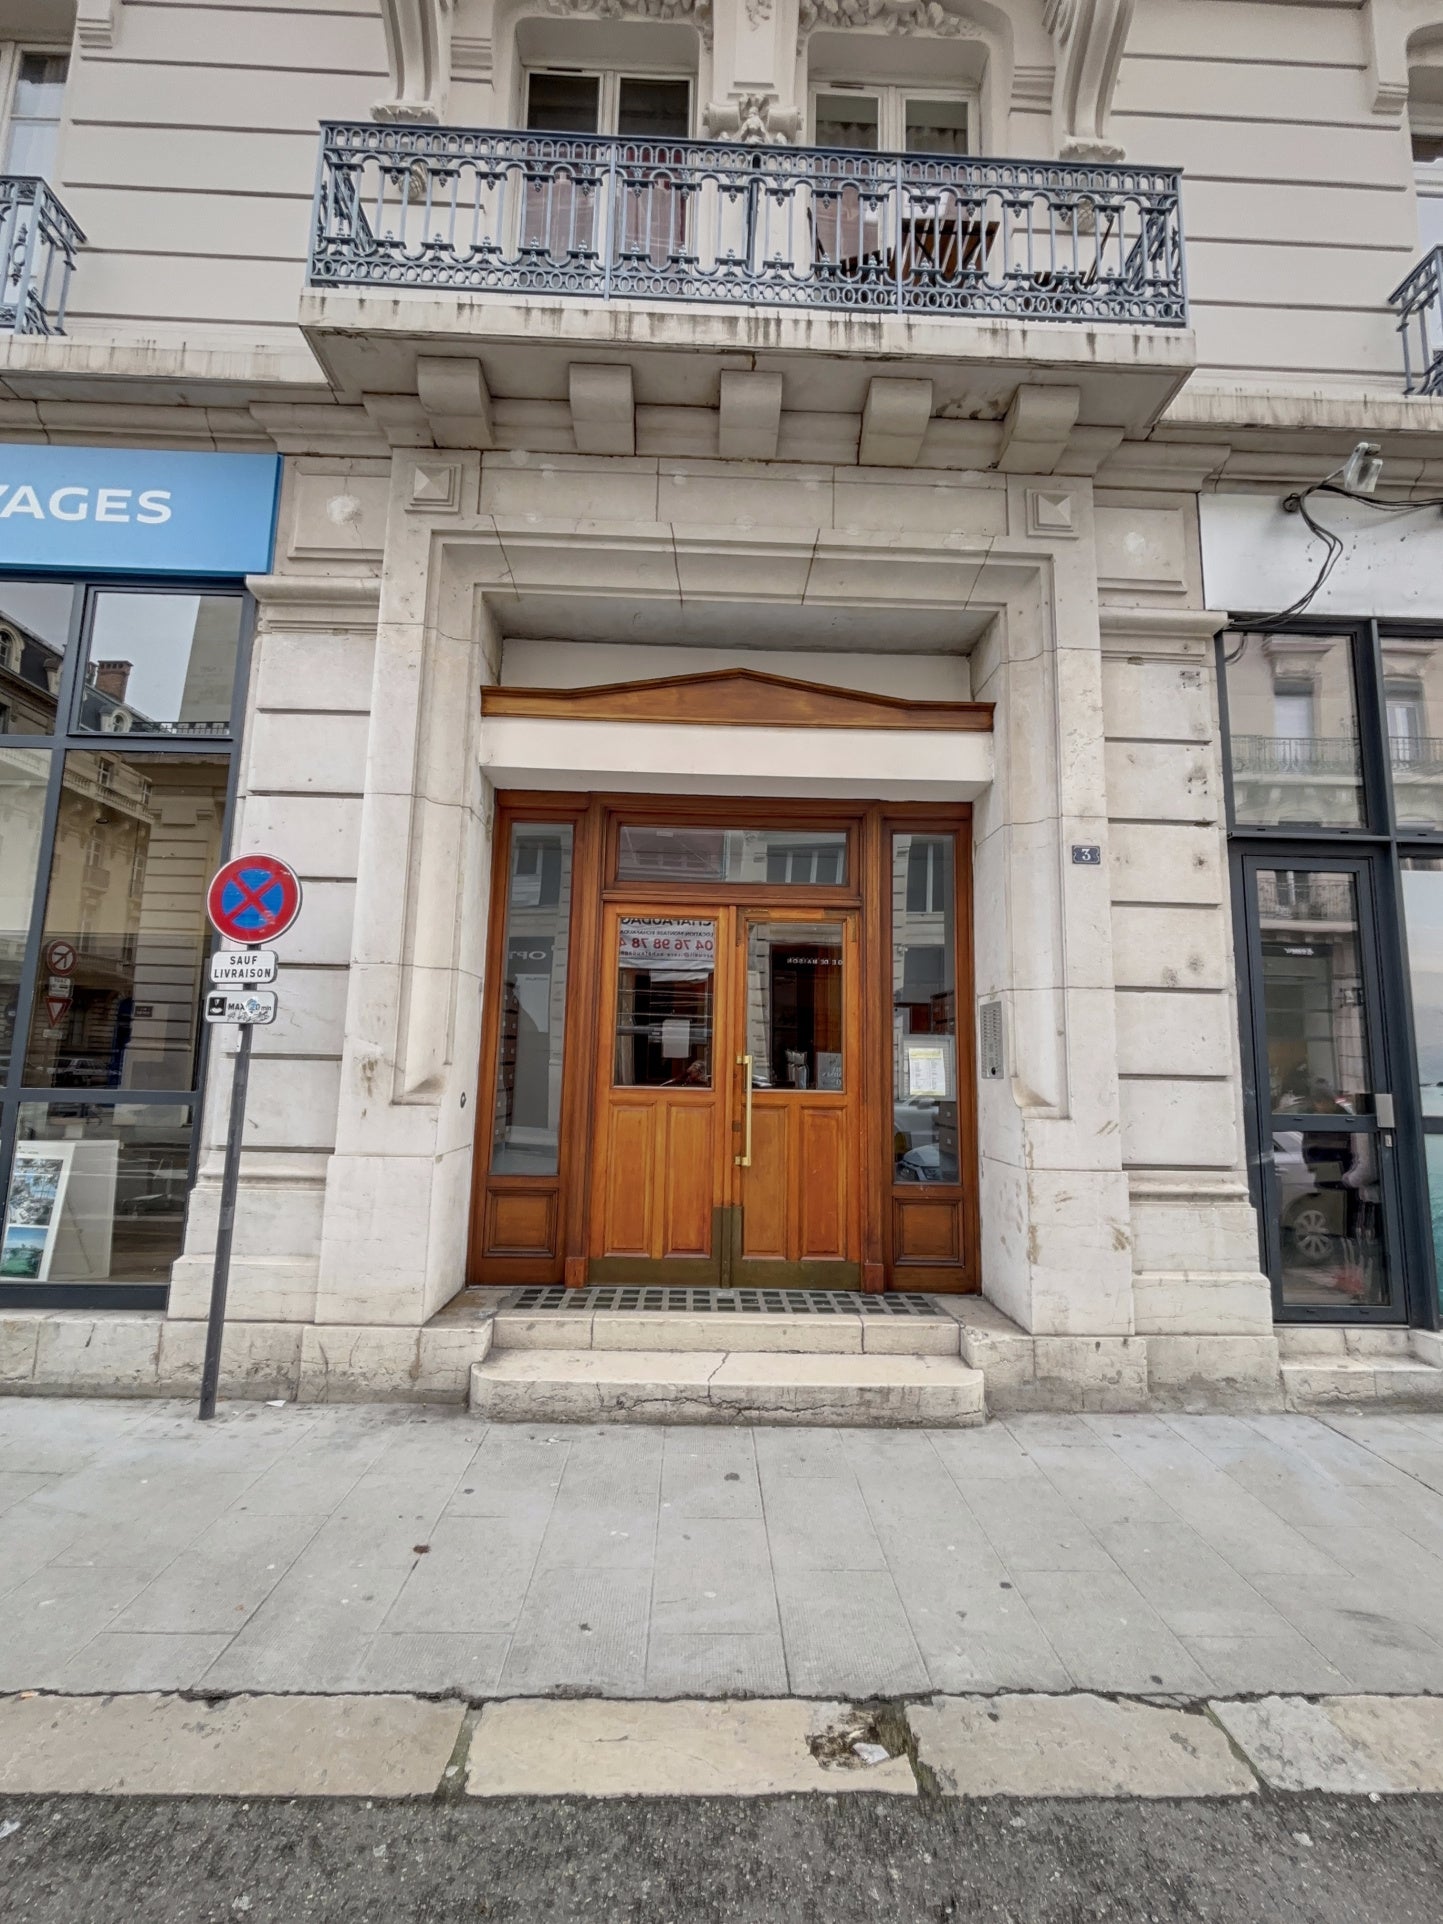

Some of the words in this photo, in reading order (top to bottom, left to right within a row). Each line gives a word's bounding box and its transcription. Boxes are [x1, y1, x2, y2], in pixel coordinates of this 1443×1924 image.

[1081, 848, 1091, 861] 3
[229, 955, 258, 965] SAUF
[213, 968, 271, 979] LIVRAISON
